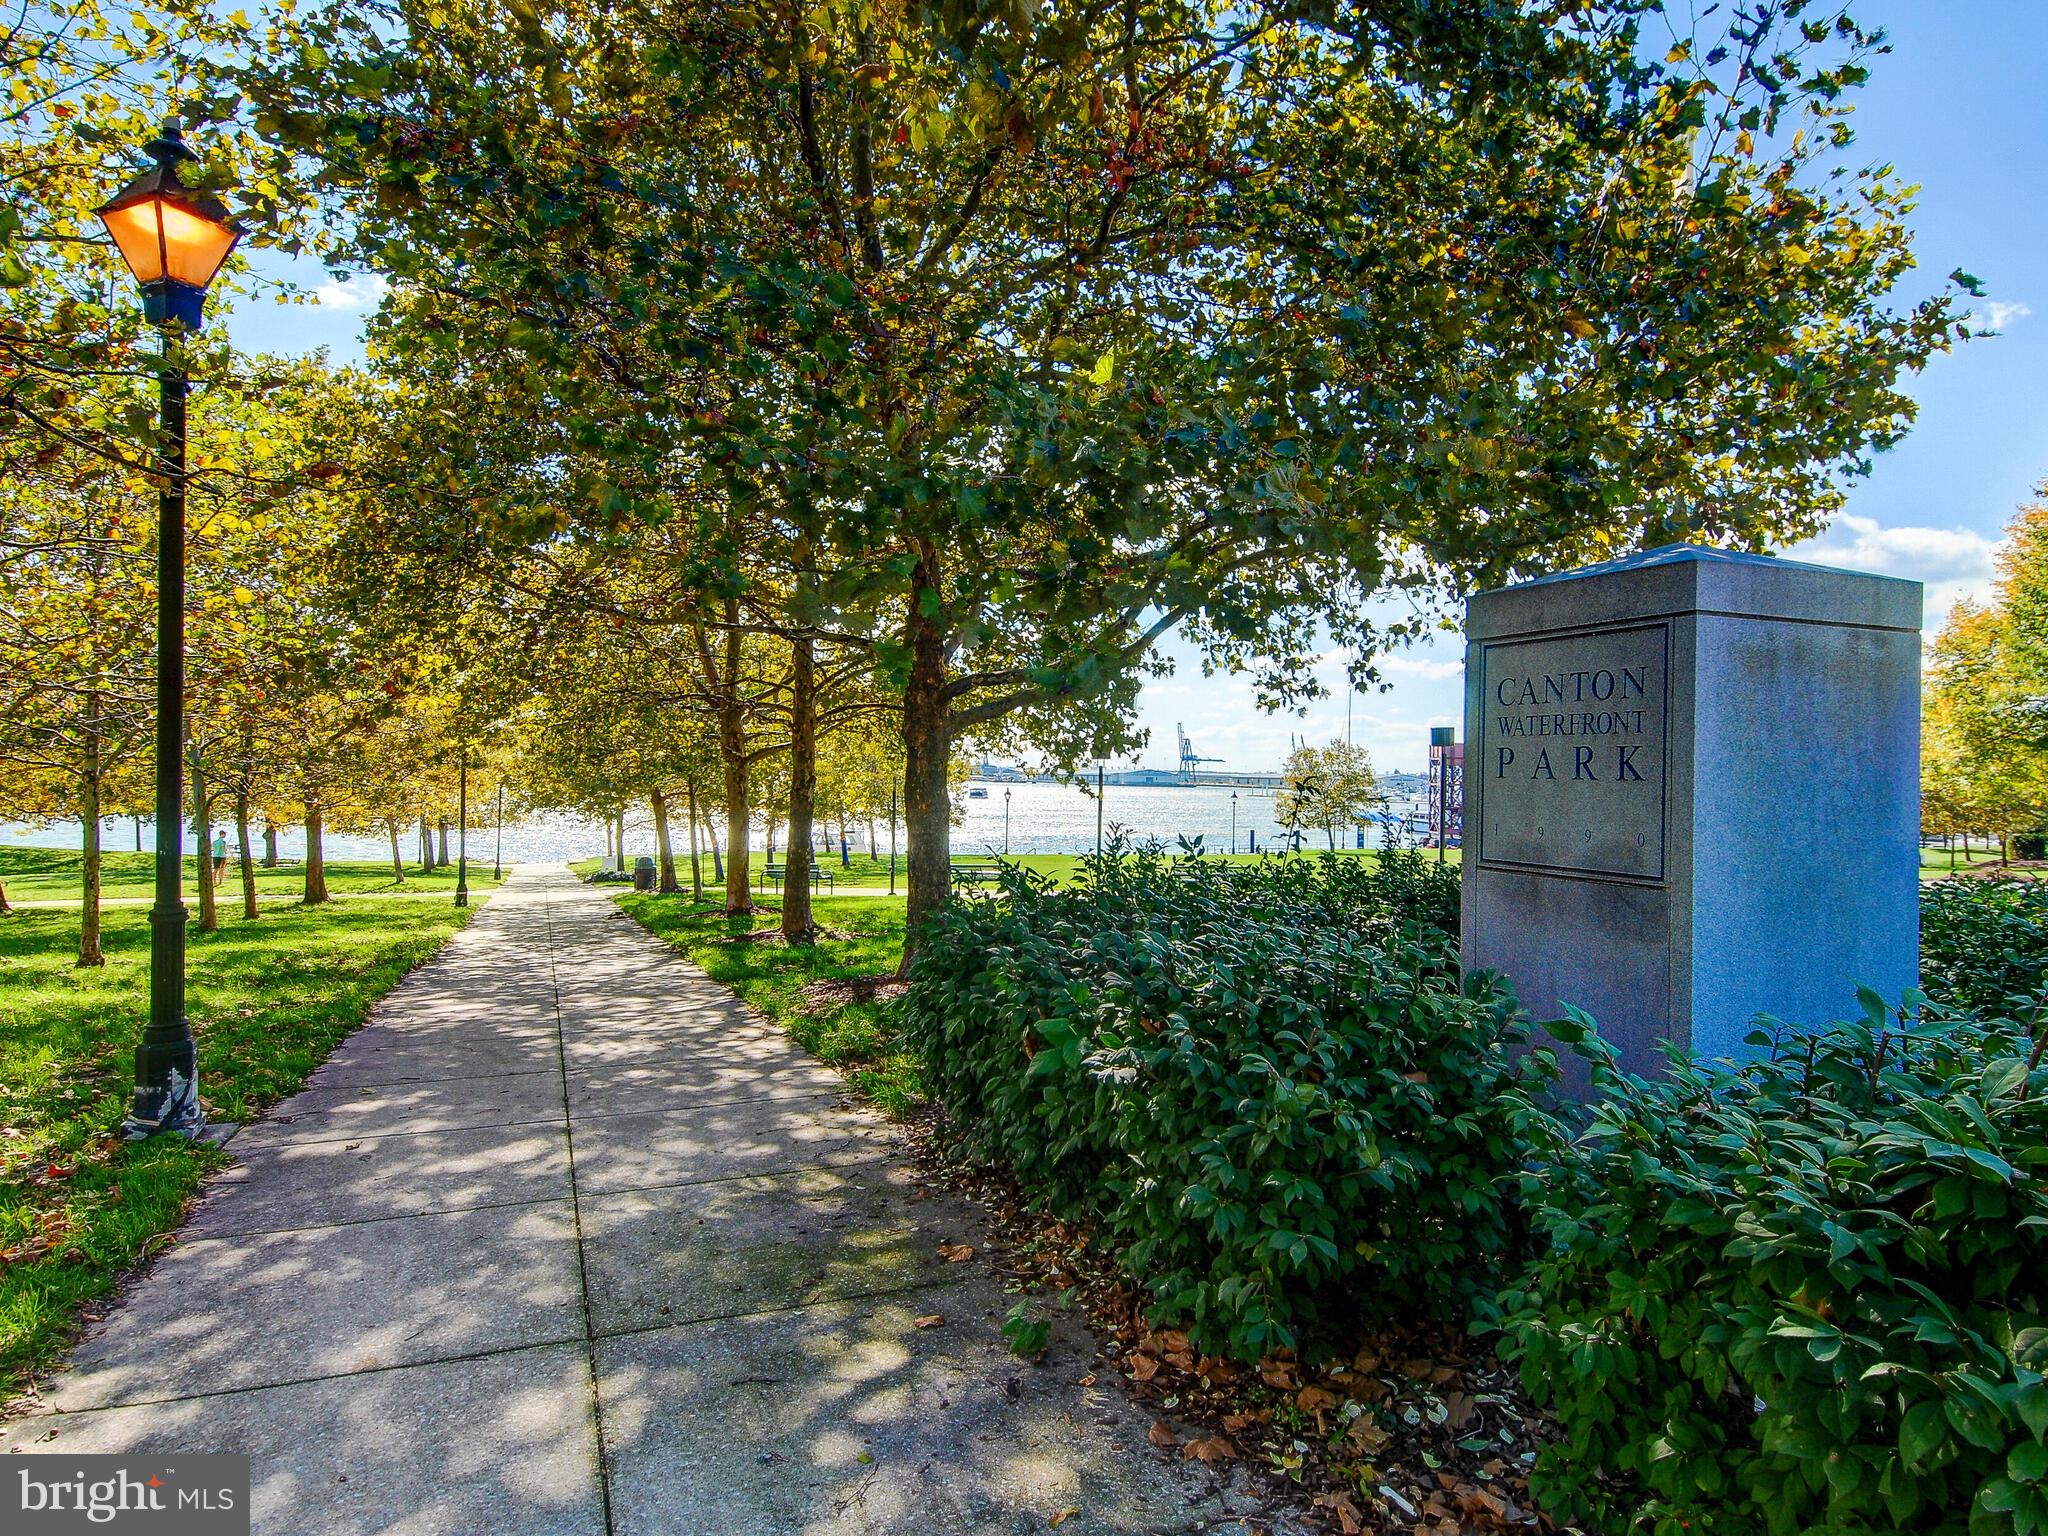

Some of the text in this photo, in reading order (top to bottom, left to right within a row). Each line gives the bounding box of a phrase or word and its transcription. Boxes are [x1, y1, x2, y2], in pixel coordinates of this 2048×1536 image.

[1497, 666, 1648, 706] CANTON
[1497, 710, 1647, 737] WATERFRONT
[1496, 745, 1646, 782] PARK
[1493, 823, 1646, 847] 1990
